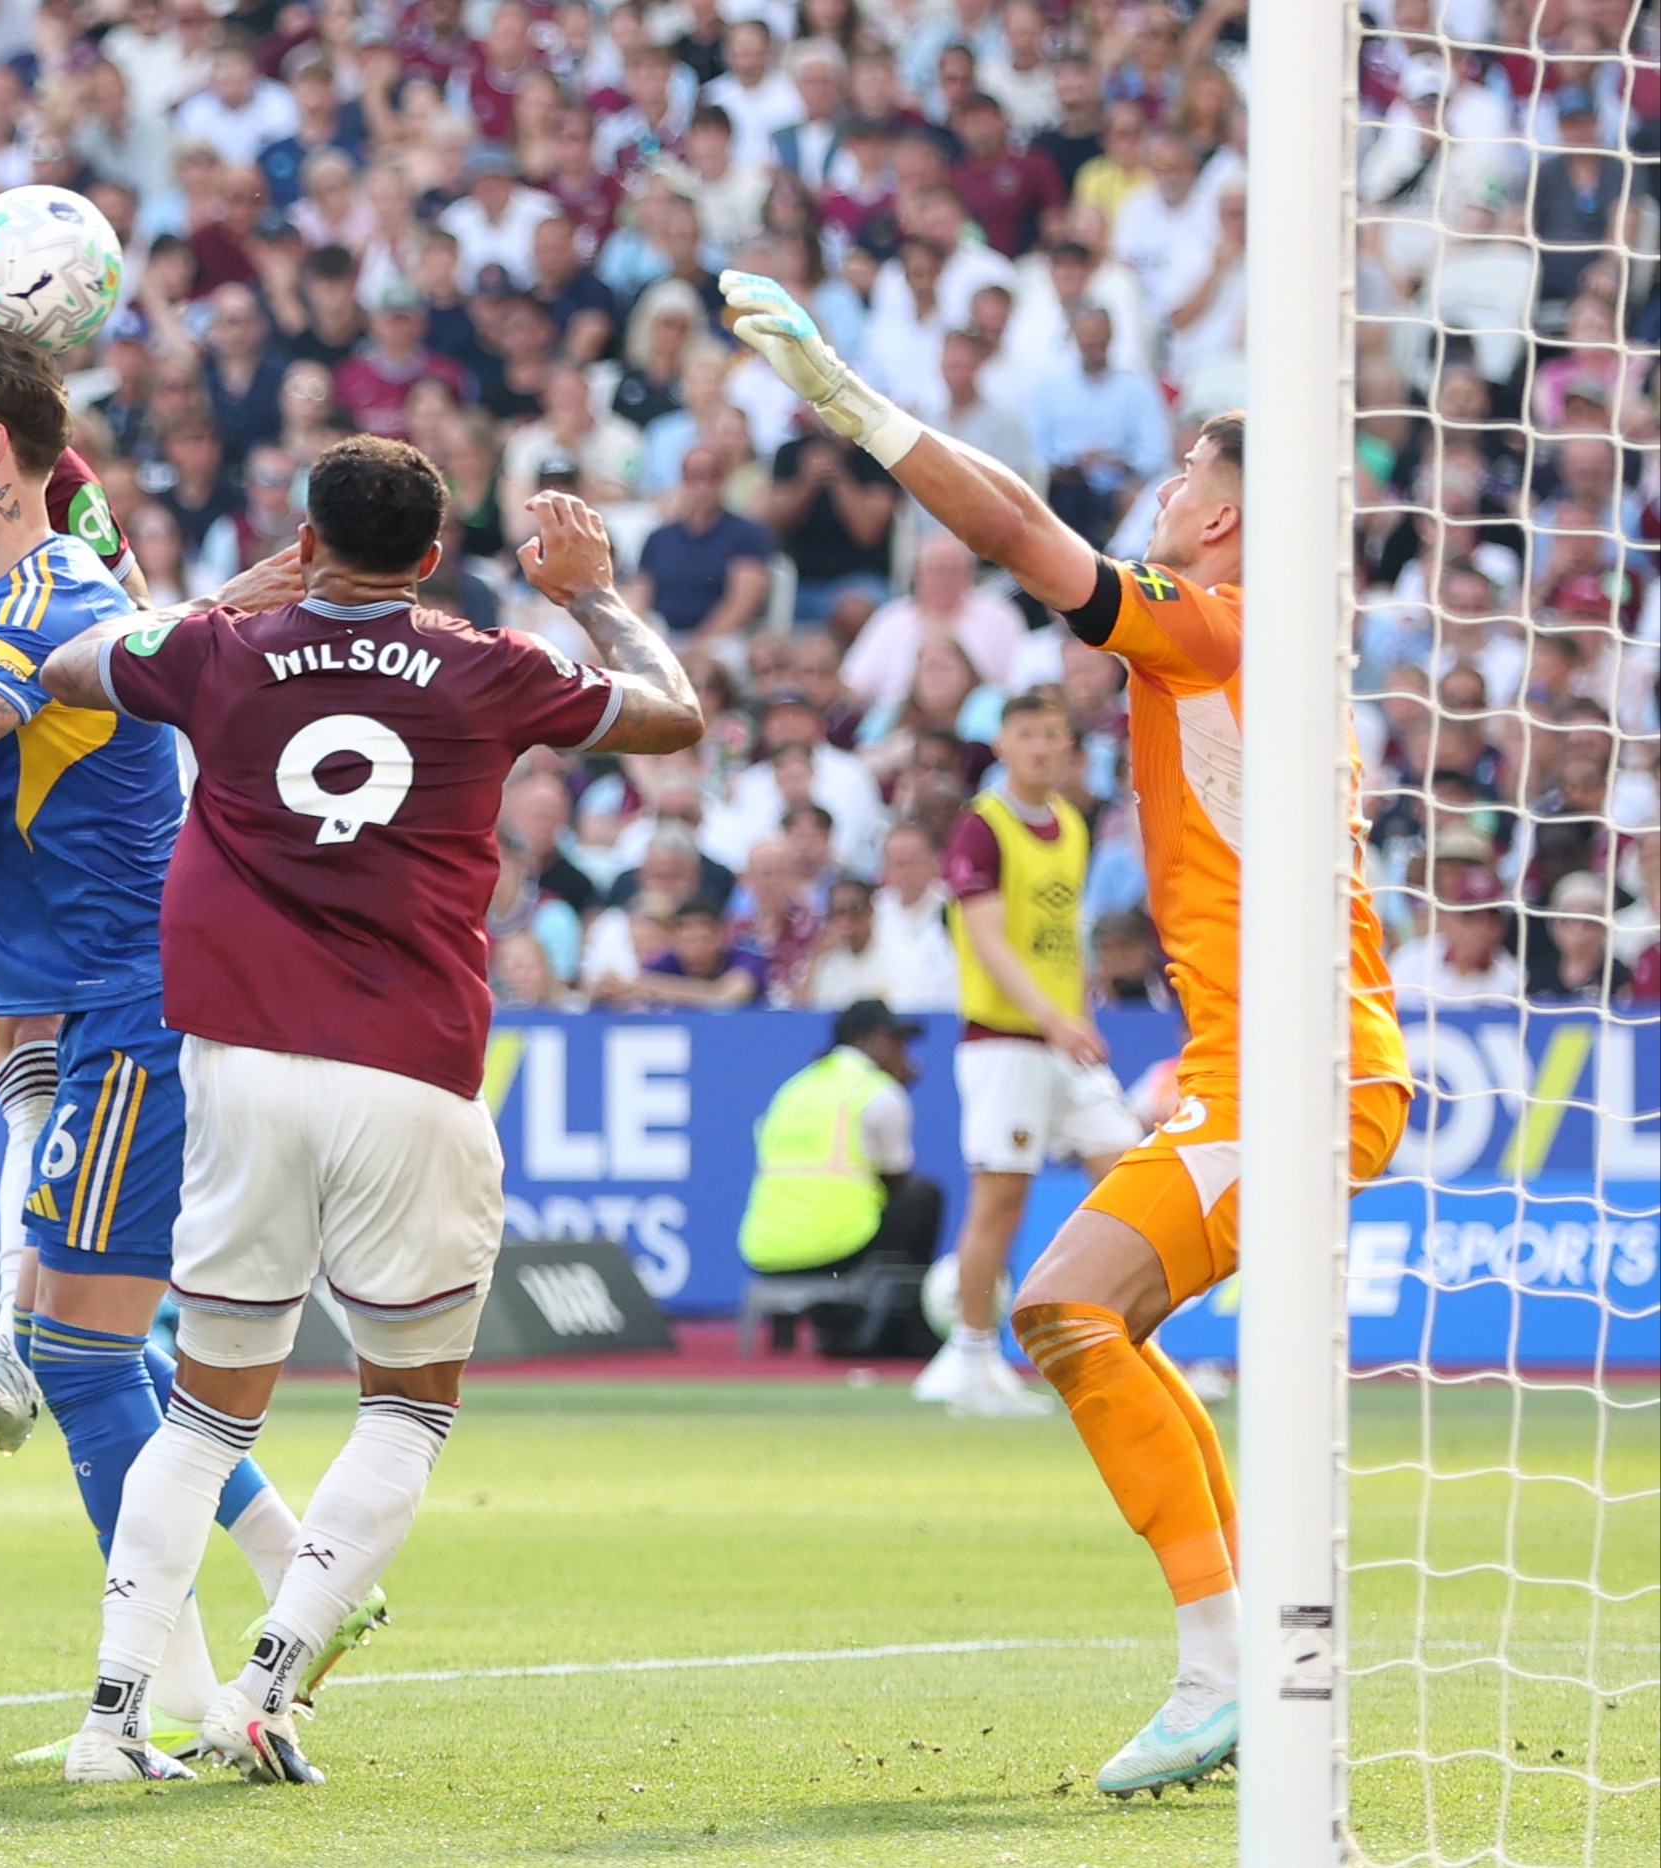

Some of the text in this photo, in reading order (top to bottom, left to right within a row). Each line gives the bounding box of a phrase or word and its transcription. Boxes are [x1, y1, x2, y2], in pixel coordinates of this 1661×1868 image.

[266, 640, 442, 687] WILSON
[276, 714, 414, 844] 9
[40, 1103, 78, 1179] 6
[1414, 1220, 1659, 1287] SPORTS
